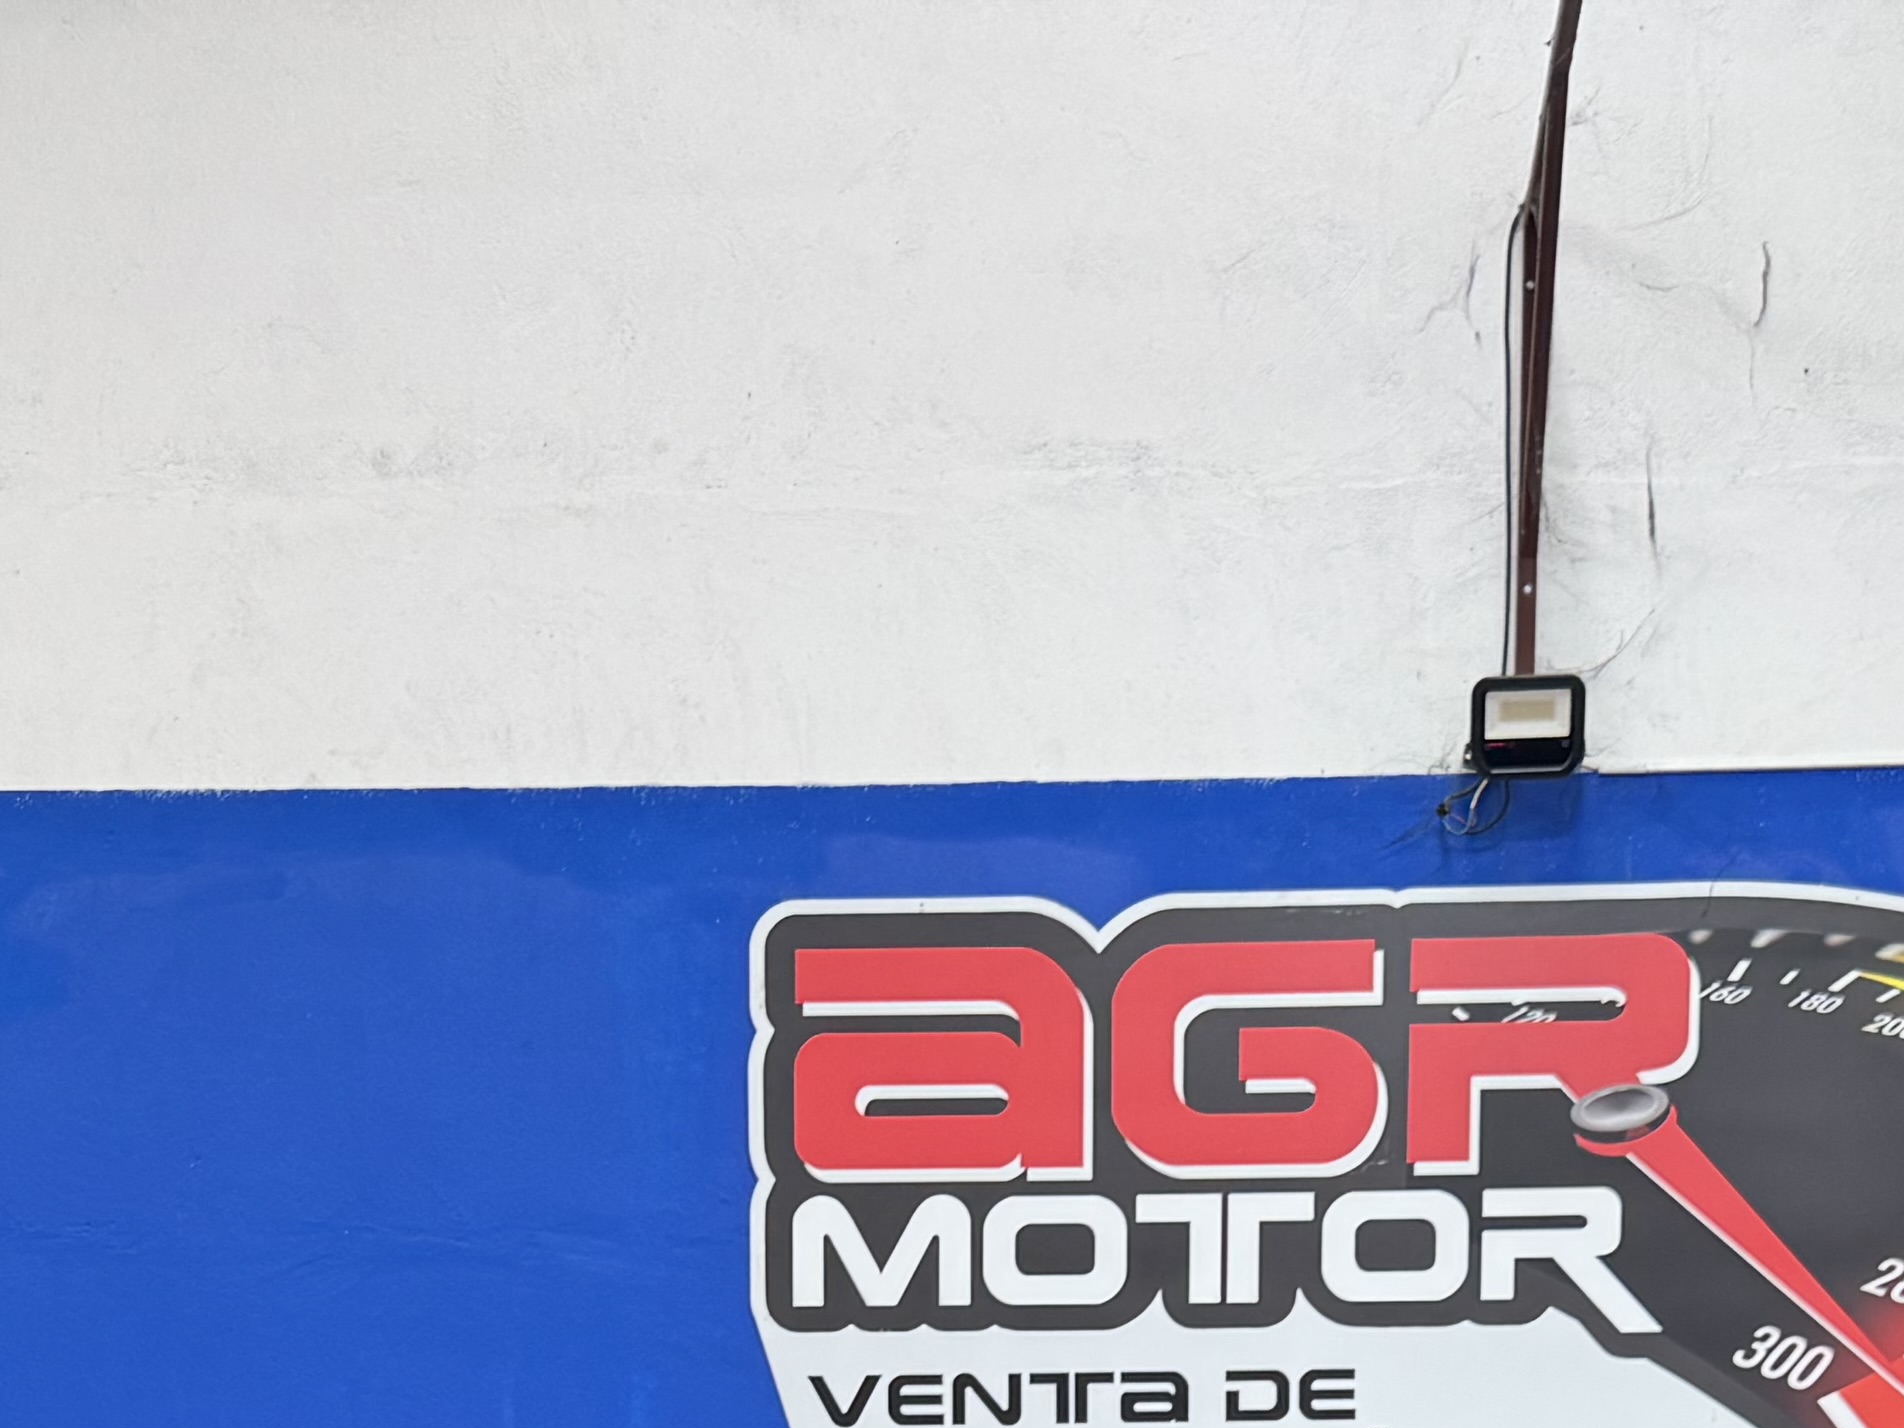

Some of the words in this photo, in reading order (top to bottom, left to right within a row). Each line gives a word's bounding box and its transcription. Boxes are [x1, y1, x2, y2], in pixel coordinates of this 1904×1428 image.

[1698, 980, 1752, 1005] 160
[1788, 988, 1845, 1015] 180
[792, 1188, 1662, 1334] MOTOR
[1731, 1325, 1836, 1392] 300
[1225, 1368, 1356, 1422] DE
